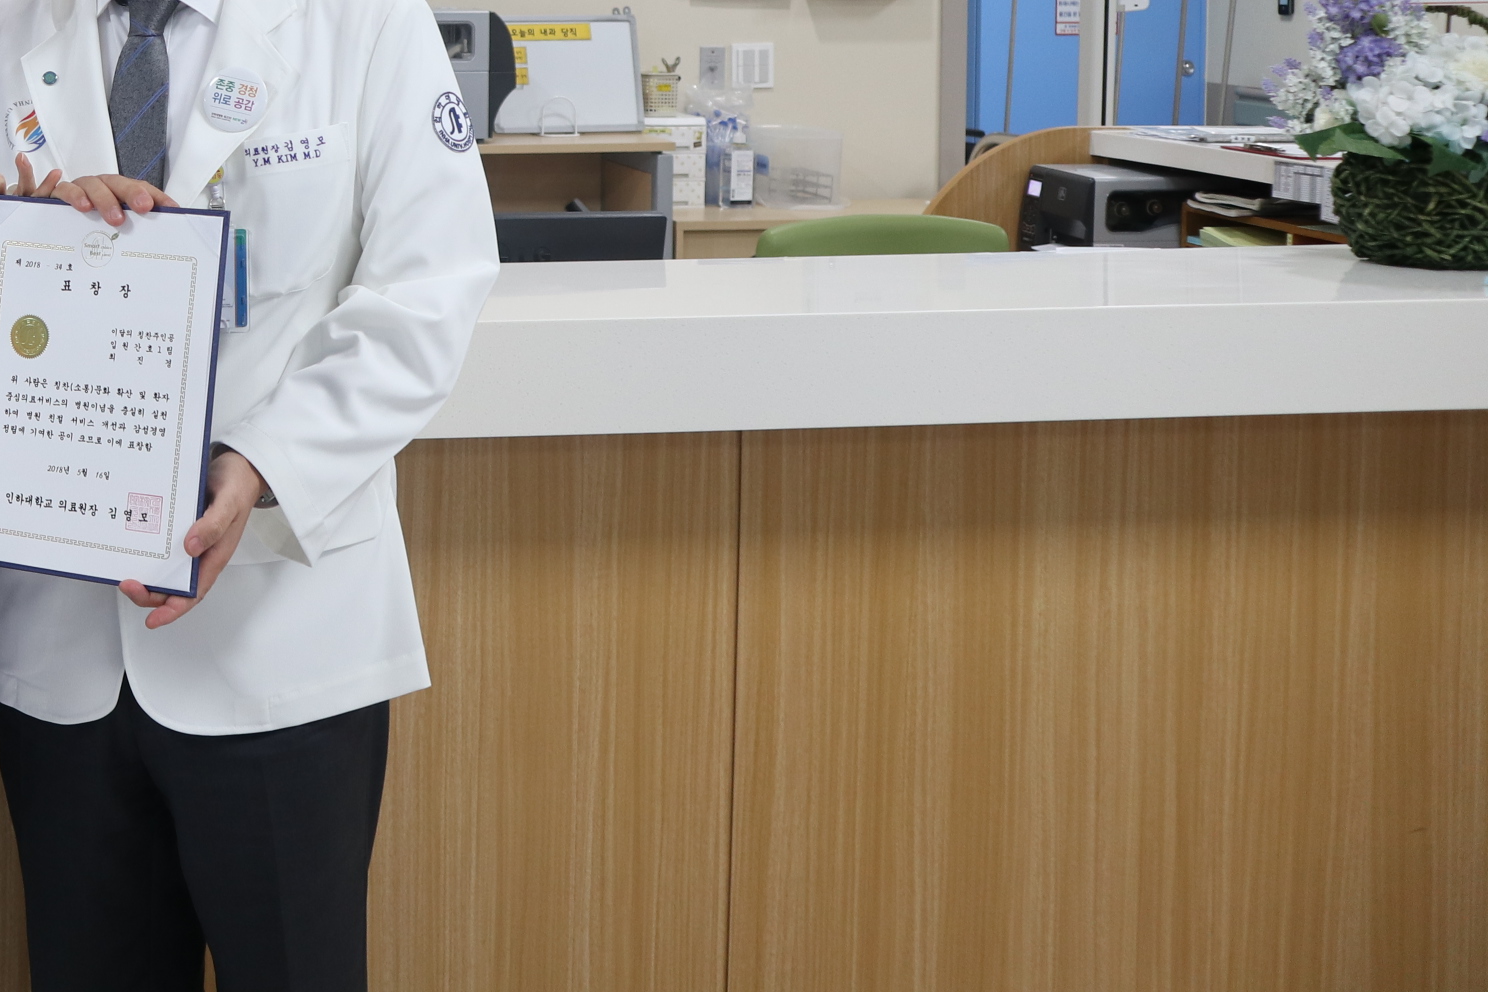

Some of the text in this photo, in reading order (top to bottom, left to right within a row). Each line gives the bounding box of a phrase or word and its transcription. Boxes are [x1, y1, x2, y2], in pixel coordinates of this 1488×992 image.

[511, 29, 535, 37] 오늘의
[561, 28, 577, 37] 당직
[216, 78, 258, 98] 존중 경청
[212, 92, 255, 112] 위로 공감
[244, 144, 280, 157] 의료원장
[277, 153, 298, 164] KIM
[25, 260, 41, 269] 2018
[112, 328, 132, 338] 이달의
[11, 375, 18, 384] 위
[24, 377, 48, 388] 사람은
[116, 388, 132, 398] 확산
[139, 391, 146, 400] 및
[153, 392, 170, 403] 환자
[121, 406, 144, 417] 충실히
[152, 410, 167, 420] 실천
[4, 408, 166, 437] 하여 병원 친절 서비스 개선과 감성경영
[30, 428, 53, 439] 기여한
[58, 431, 73, 442] 공이
[78, 434, 102, 444] 크므로
[107, 438, 122, 447] 이에
[47, 465, 110, 481] 2018년 5월 16일
[5, 492, 53, 509] 인하대학교
[58, 500, 98, 517] 의료원장
